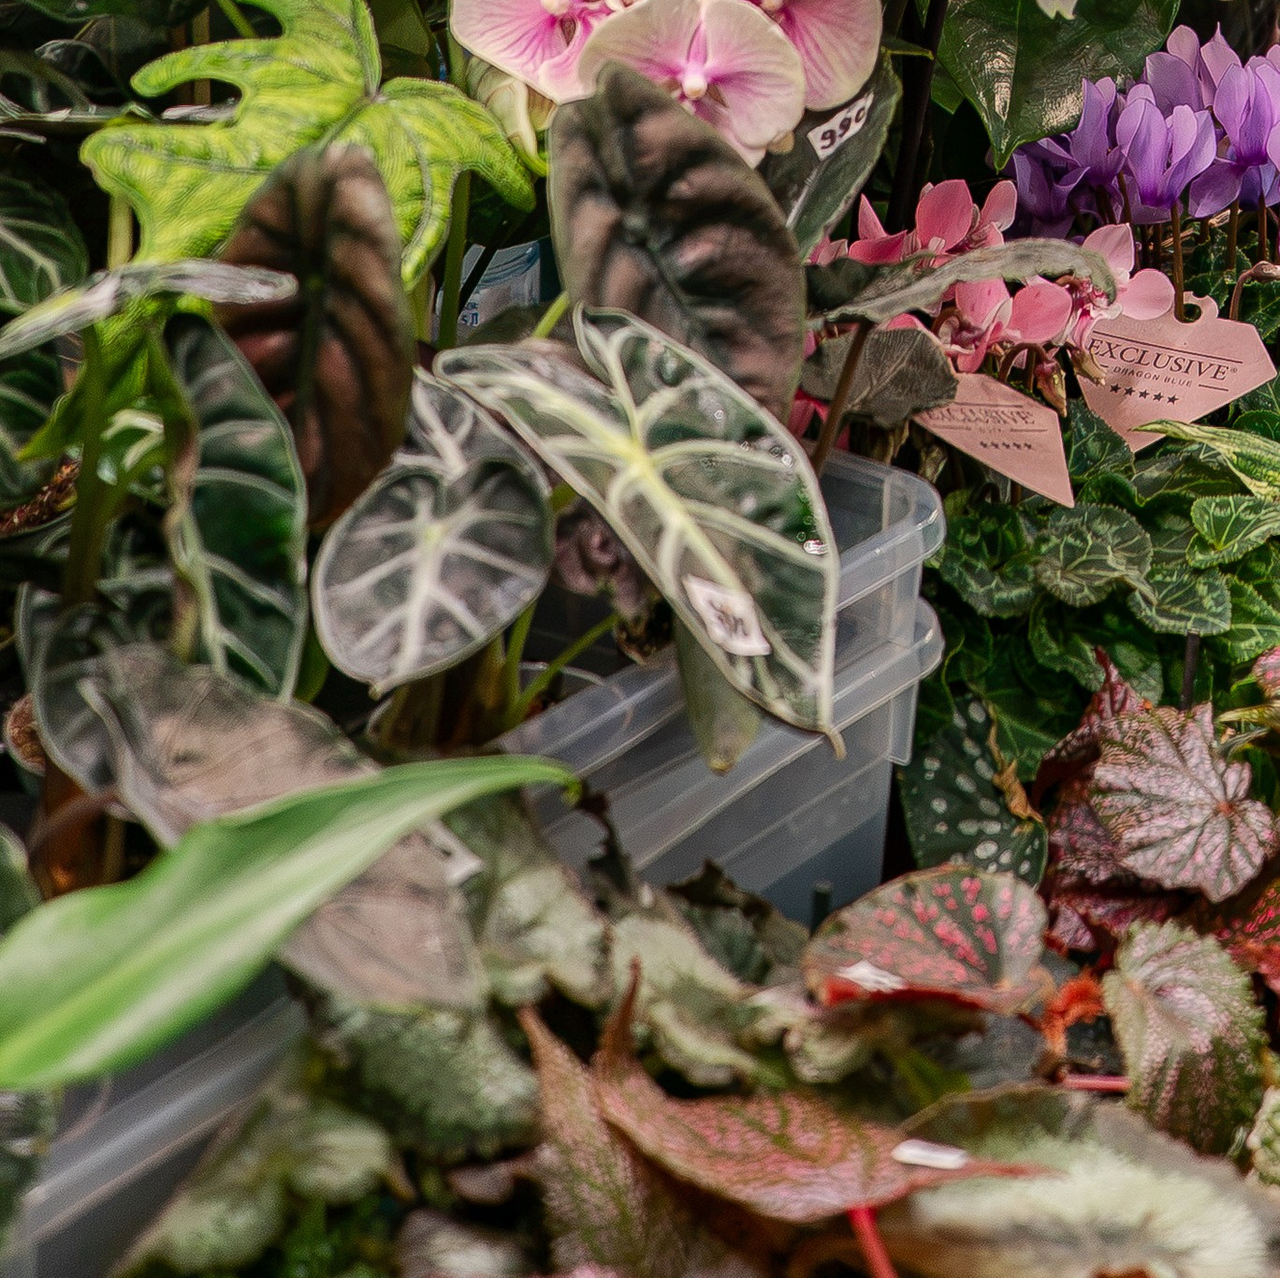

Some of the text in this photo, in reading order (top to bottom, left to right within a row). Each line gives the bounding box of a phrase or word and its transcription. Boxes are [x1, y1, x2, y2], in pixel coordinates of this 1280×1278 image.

[821, 106, 867, 150] 990
[1112, 365, 1194, 388] DRAGON BLUE
